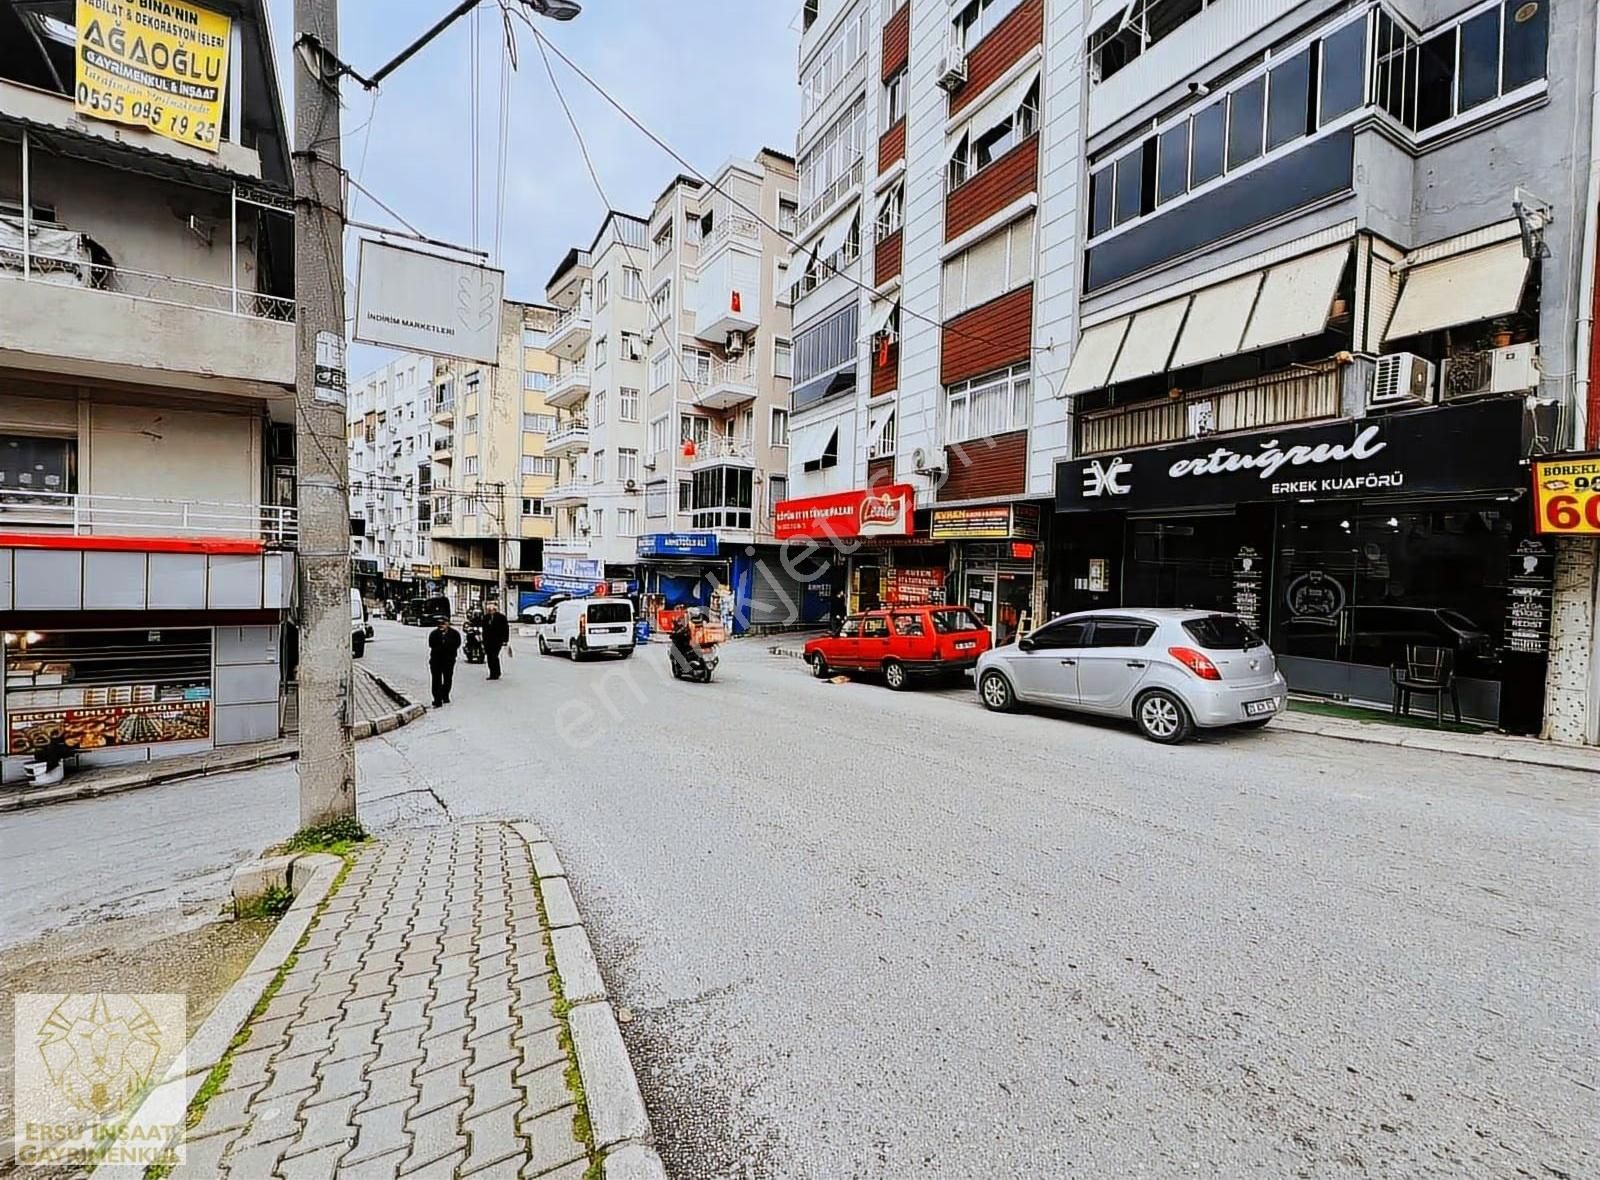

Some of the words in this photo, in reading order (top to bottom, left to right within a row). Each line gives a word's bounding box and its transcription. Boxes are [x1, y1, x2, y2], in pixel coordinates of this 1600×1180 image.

[135, 12, 196, 41] DEKORASYON
[83, 19, 221, 81] AĞAOĞLU
[170, 115, 189, 135] 19
[194, 121, 216, 143] 25
[1168, 425, 1387, 479] ertuğrul
[1271, 480, 1317, 494] ERKEK
[1321, 470, 1403, 491] KUAFÖRÜ
[12, 712, 67, 721] ERCAN
